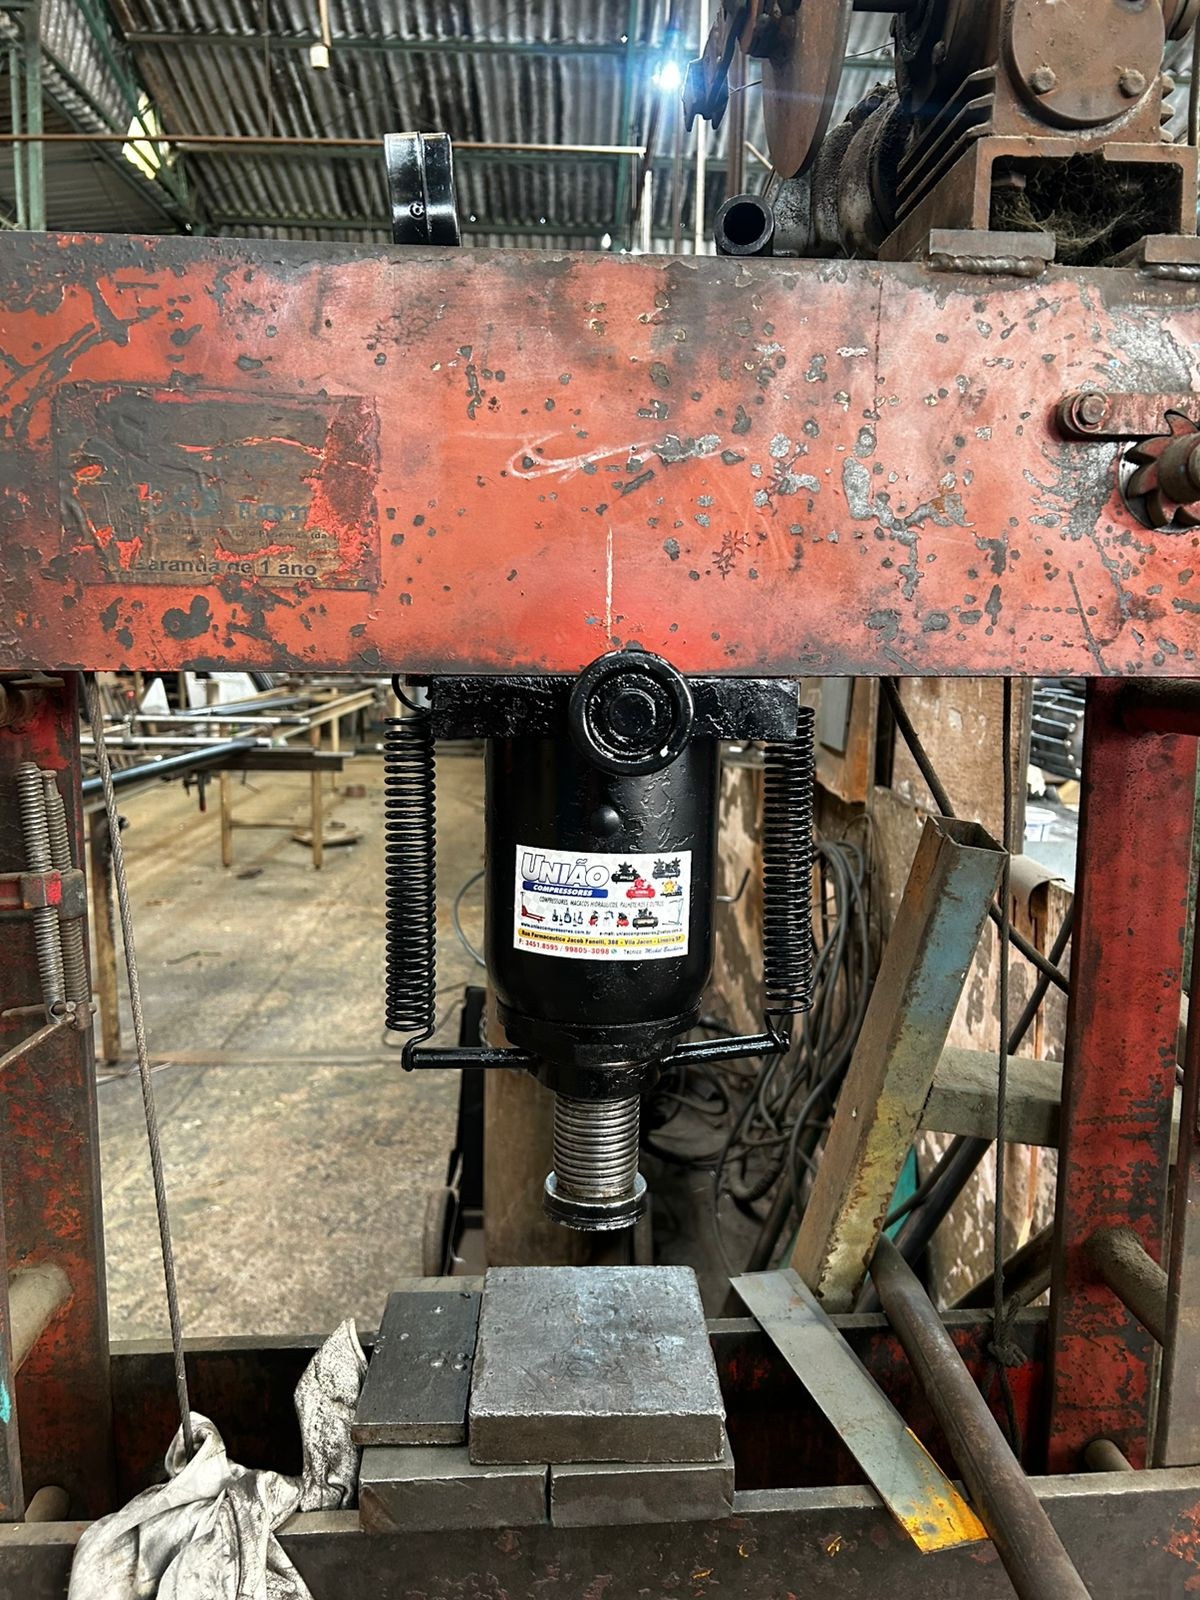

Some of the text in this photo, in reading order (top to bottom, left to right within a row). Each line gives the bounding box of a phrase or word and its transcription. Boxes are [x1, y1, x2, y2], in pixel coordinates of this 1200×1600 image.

[260, 556, 270, 575] 1
[278, 562, 317, 576] ano
[521, 852, 609, 888] UNIÃO
[532, 884, 594, 898] COMPRESSORES
[521, 929, 531, 937] Rua
